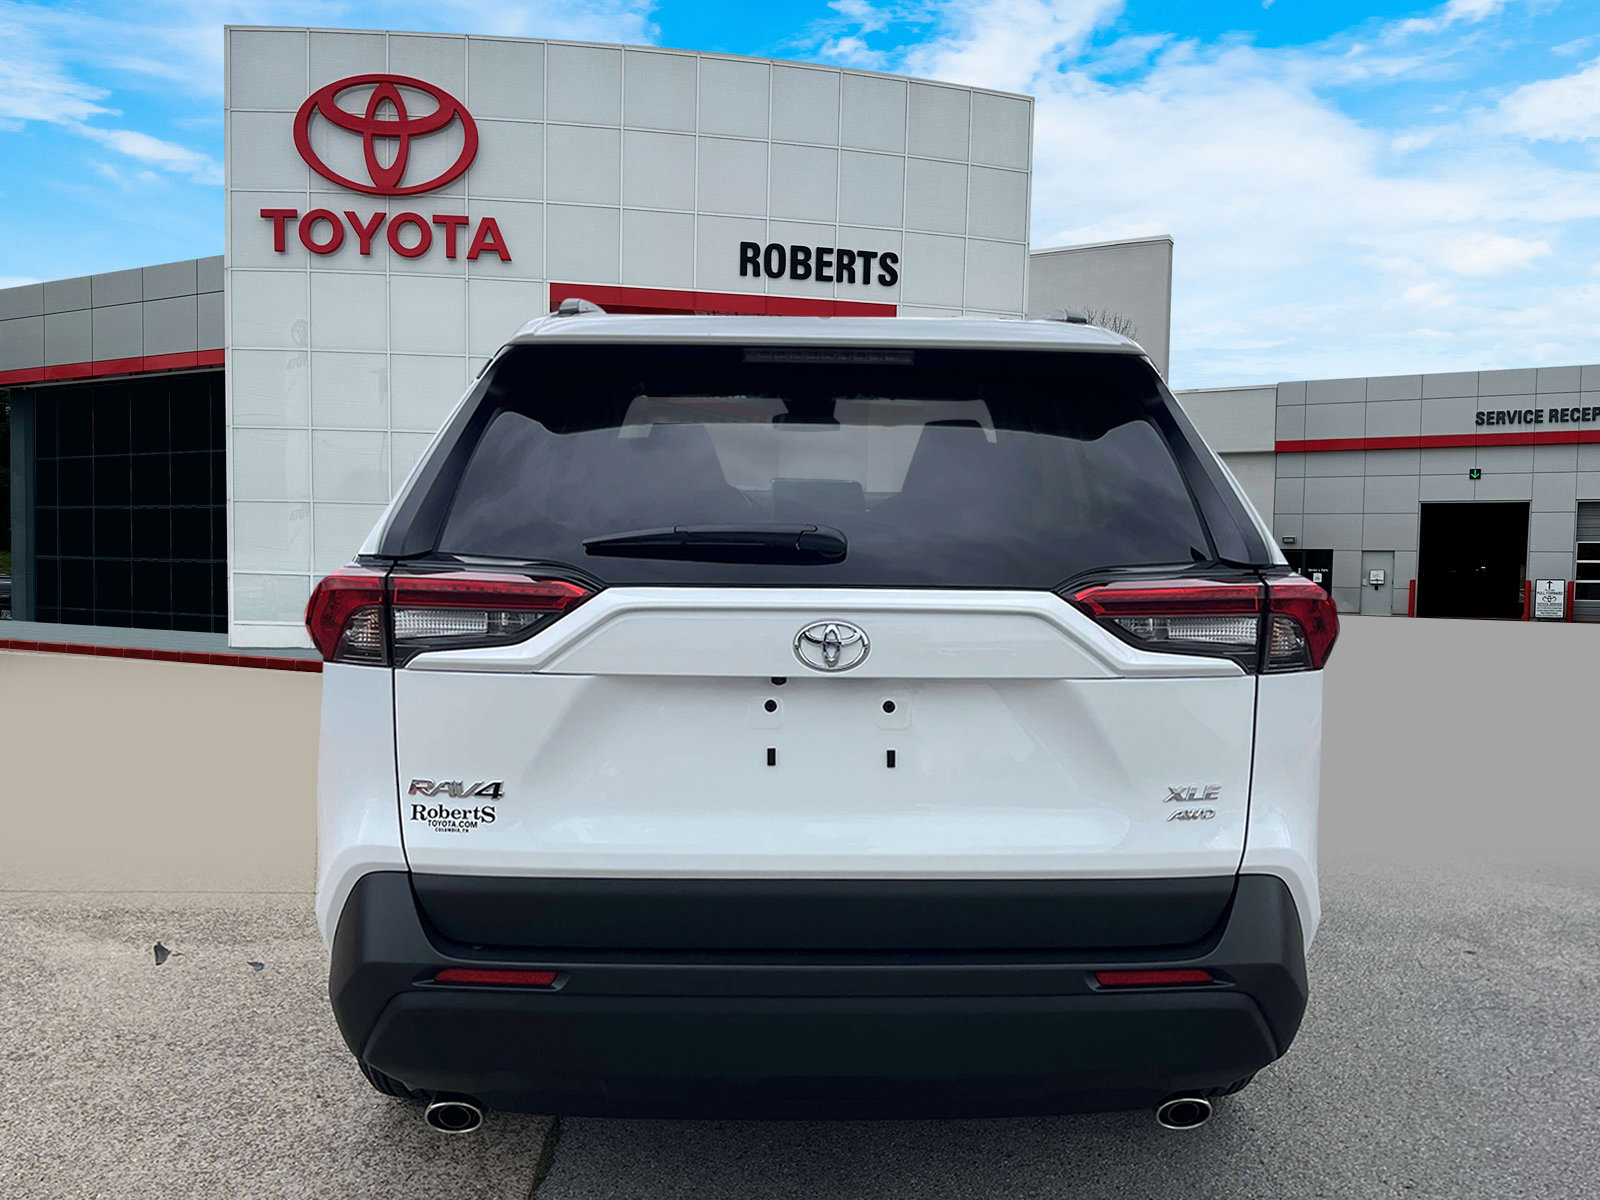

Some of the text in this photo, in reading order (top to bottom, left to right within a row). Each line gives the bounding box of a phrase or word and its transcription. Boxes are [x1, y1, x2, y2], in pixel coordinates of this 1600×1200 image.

[260, 208, 512, 262] TOYOTA
[739, 241, 899, 287] ROBERTS
[1475, 409, 1544, 426] SERVICE
[408, 779, 505, 801] RAV4
[1163, 784, 1222, 803] XLE
[428, 820, 478, 829] TOYOTA.COM
[1167, 808, 1217, 822] AWD
